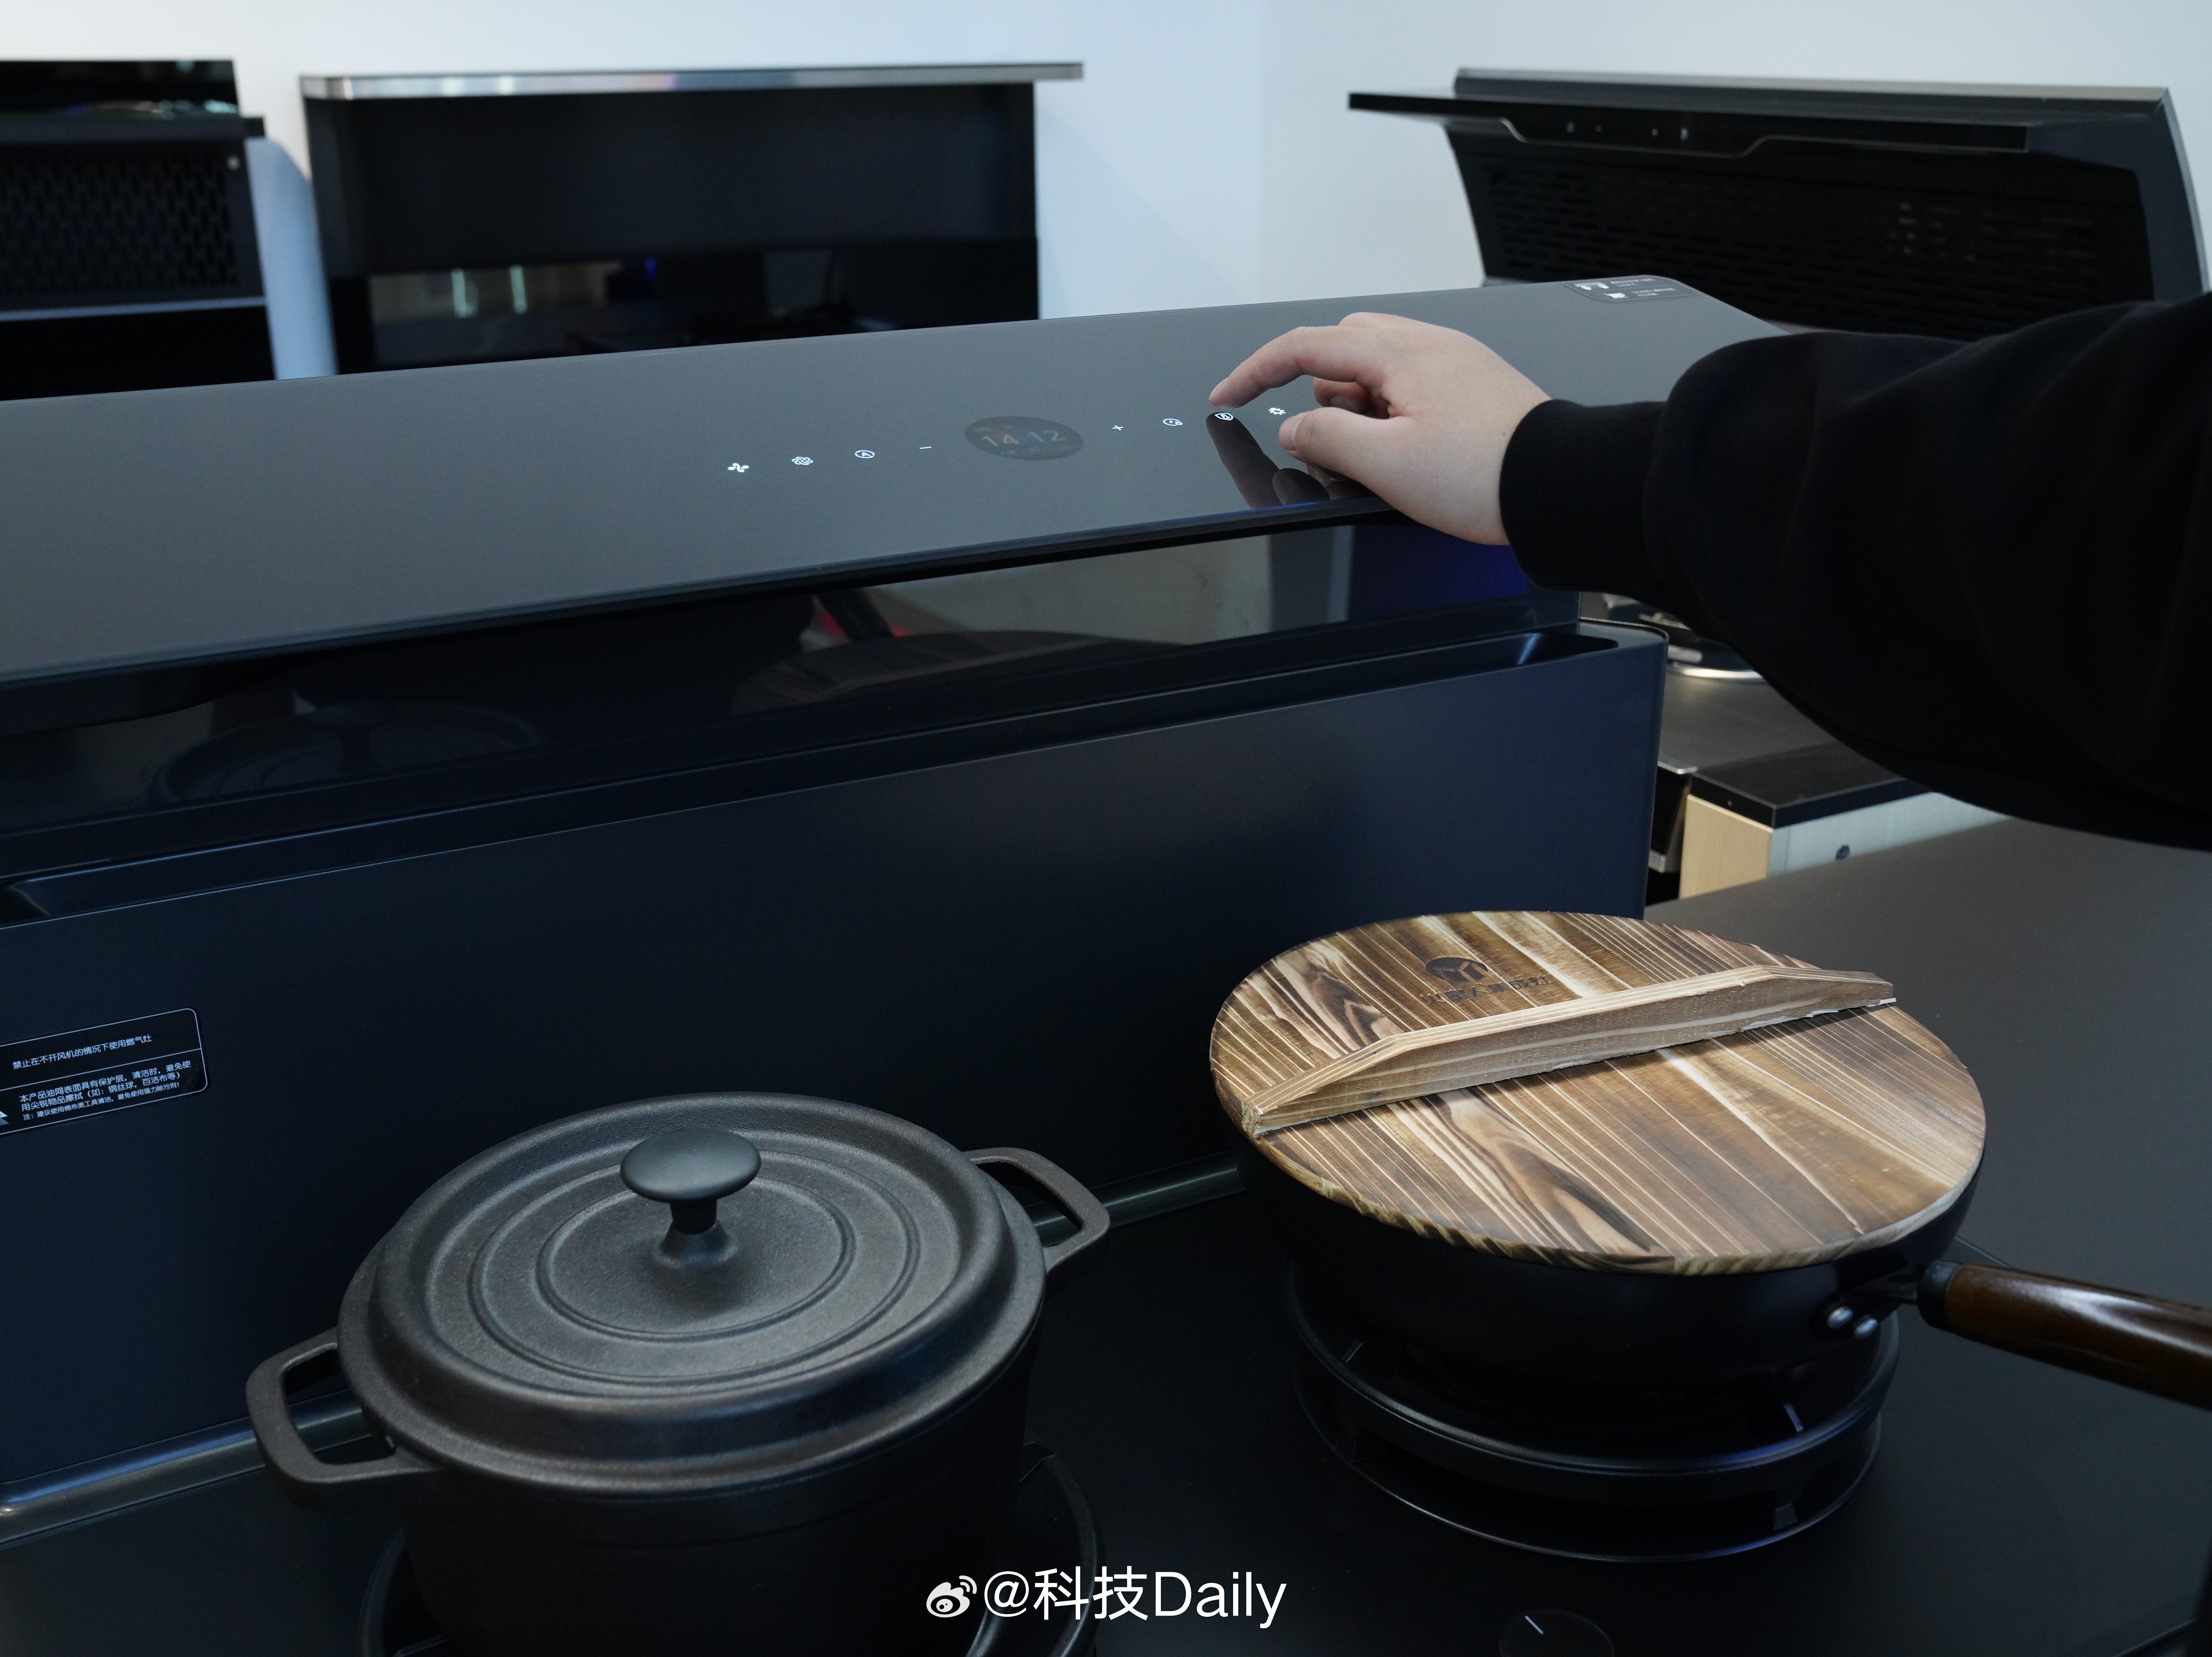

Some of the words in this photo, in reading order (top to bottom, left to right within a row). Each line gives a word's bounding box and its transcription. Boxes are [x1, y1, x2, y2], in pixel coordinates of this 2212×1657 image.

[12, 1034, 152, 1069] 禁止在不开风机的情况下使用燃气灶
